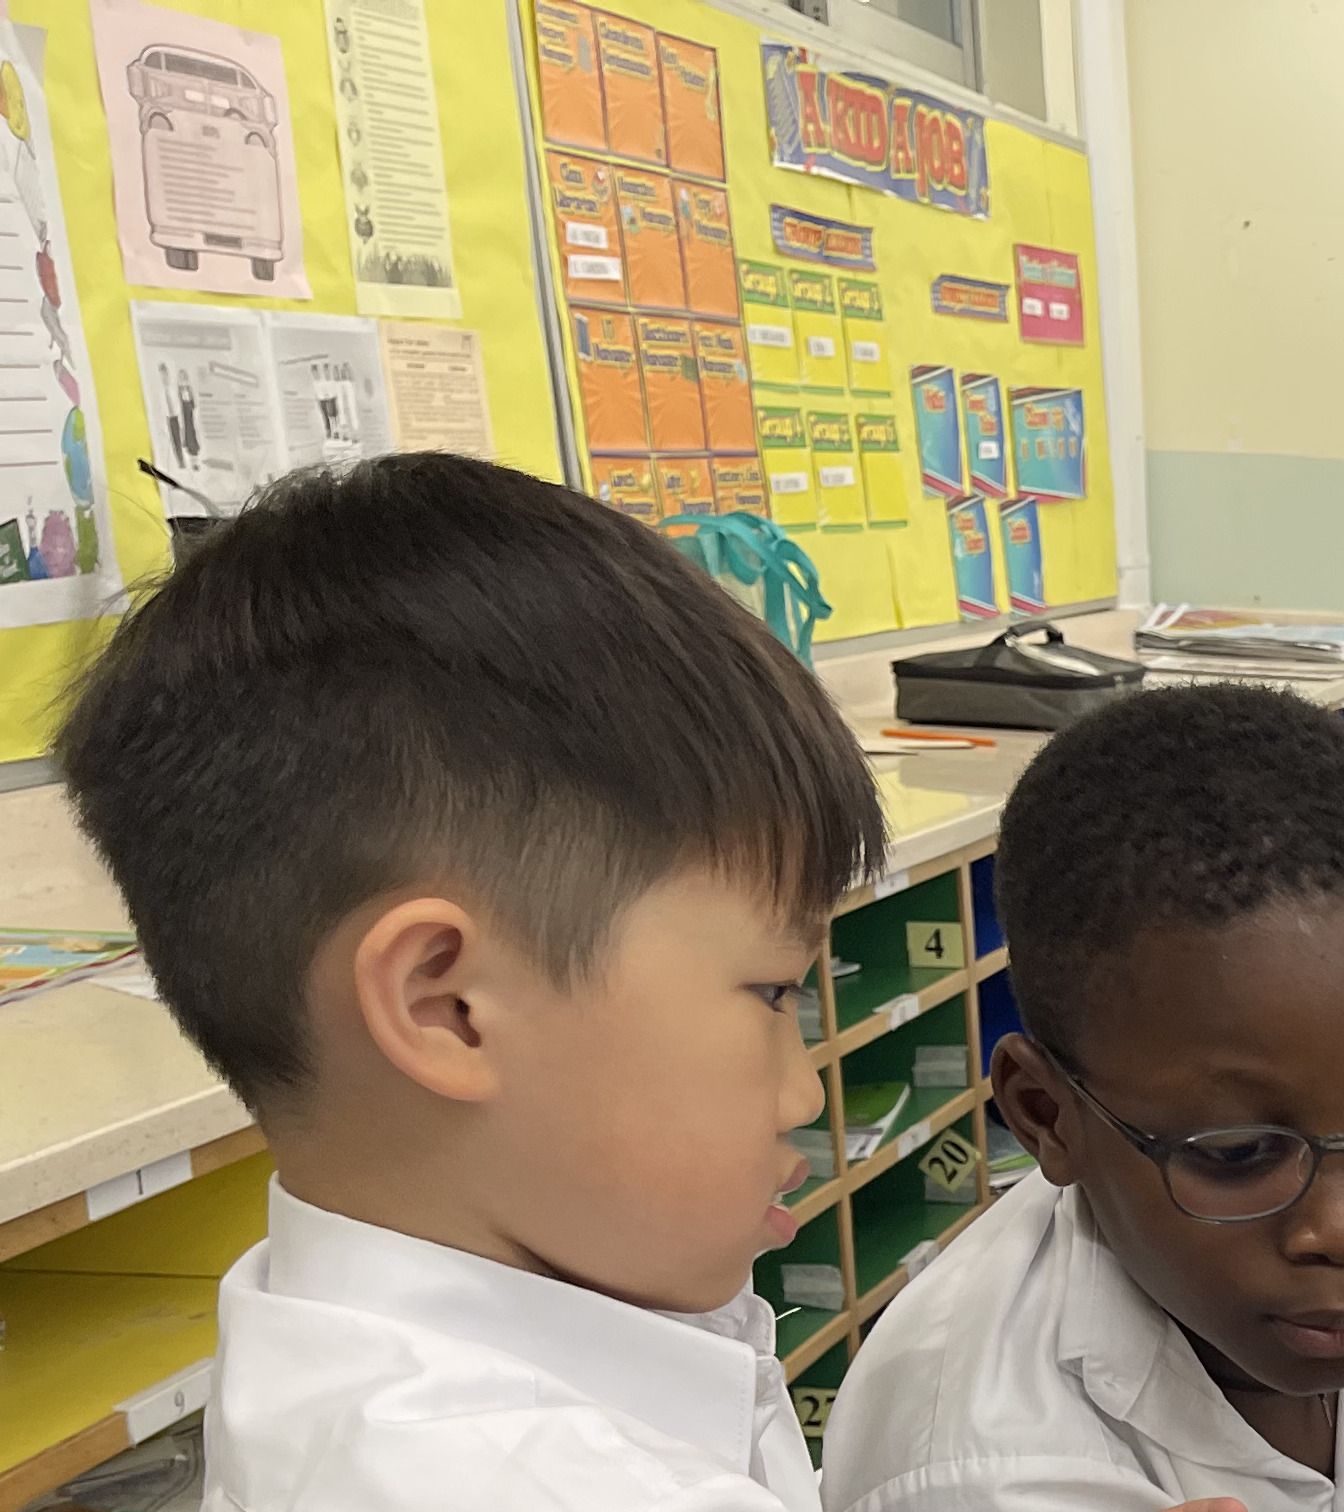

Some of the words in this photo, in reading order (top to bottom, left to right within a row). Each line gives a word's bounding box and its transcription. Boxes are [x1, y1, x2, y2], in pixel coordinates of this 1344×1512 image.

[796, 65, 831, 153] A
[826, 73, 889, 171] KID
[889, 98, 918, 179] A
[915, 104, 967, 203] JOB
[924, 928, 945, 959] 4
[928, 1139, 969, 1185] 20
